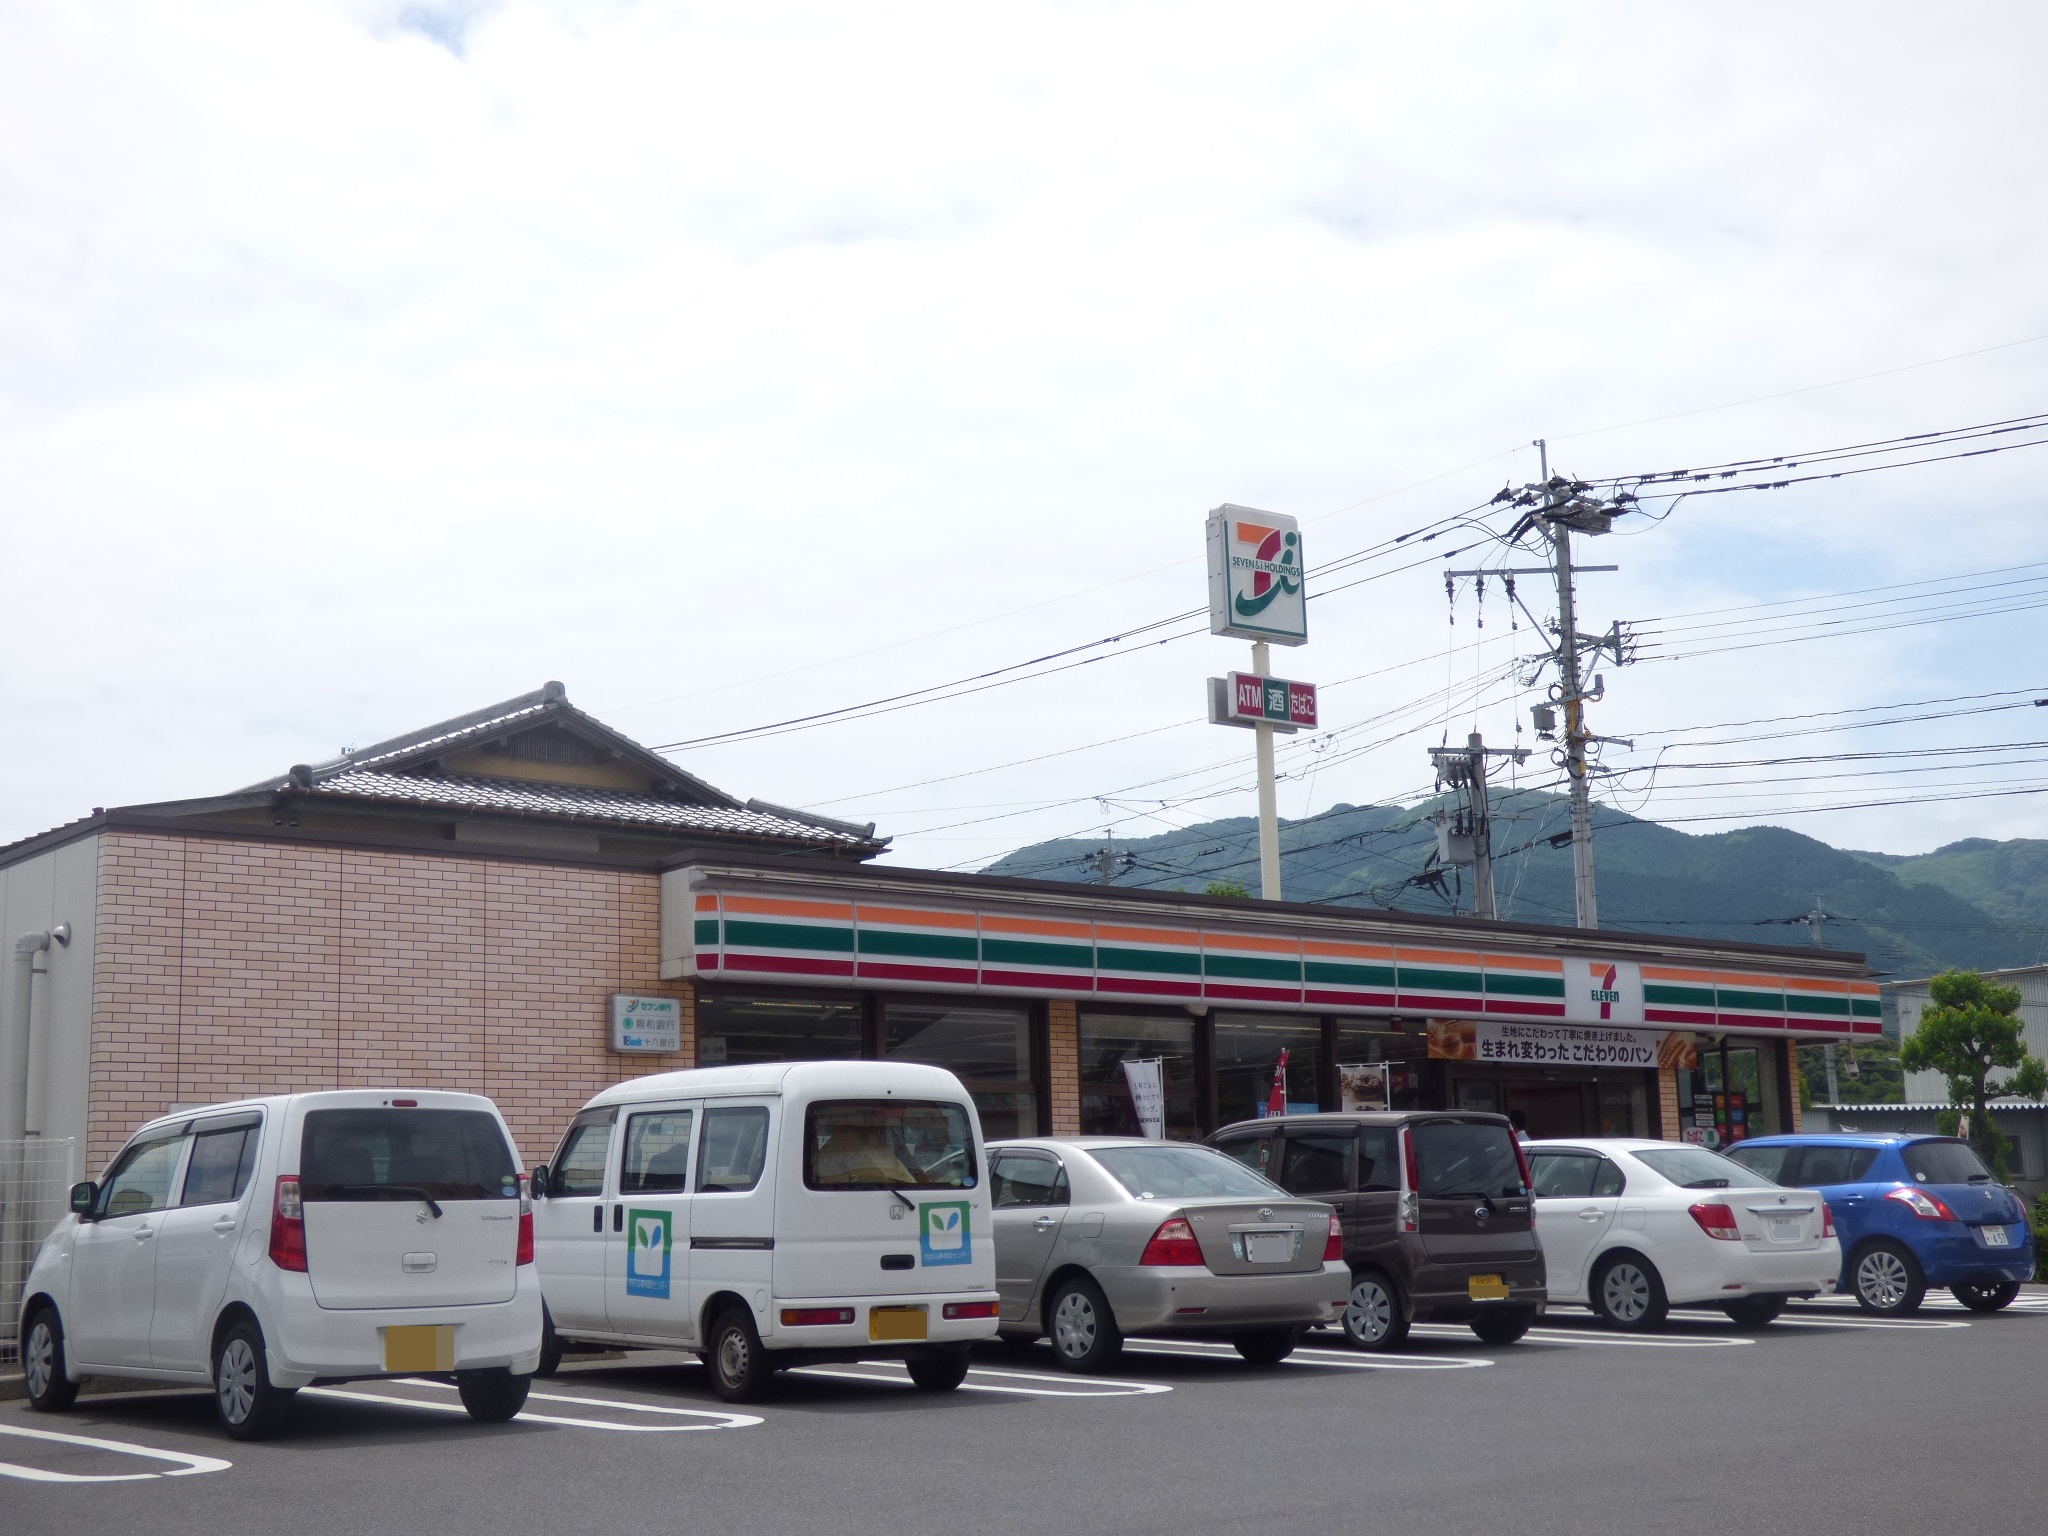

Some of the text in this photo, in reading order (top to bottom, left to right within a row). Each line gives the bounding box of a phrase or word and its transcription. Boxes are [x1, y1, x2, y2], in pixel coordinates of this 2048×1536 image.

[1264, 560, 1301, 577] HOLDINGS
[1238, 683, 1263, 709] ATM
[1268, 689, 1285, 712] 酒
[1290, 692, 1315, 716] たばこ
[636, 1019, 675, 1031] 親和銀行
[1502, 1026, 1637, 1043] 生地にこだわって丁寧に焼き上げました。
[1481, 1039, 1653, 1063] 生まれ変わった こだわりのパン
